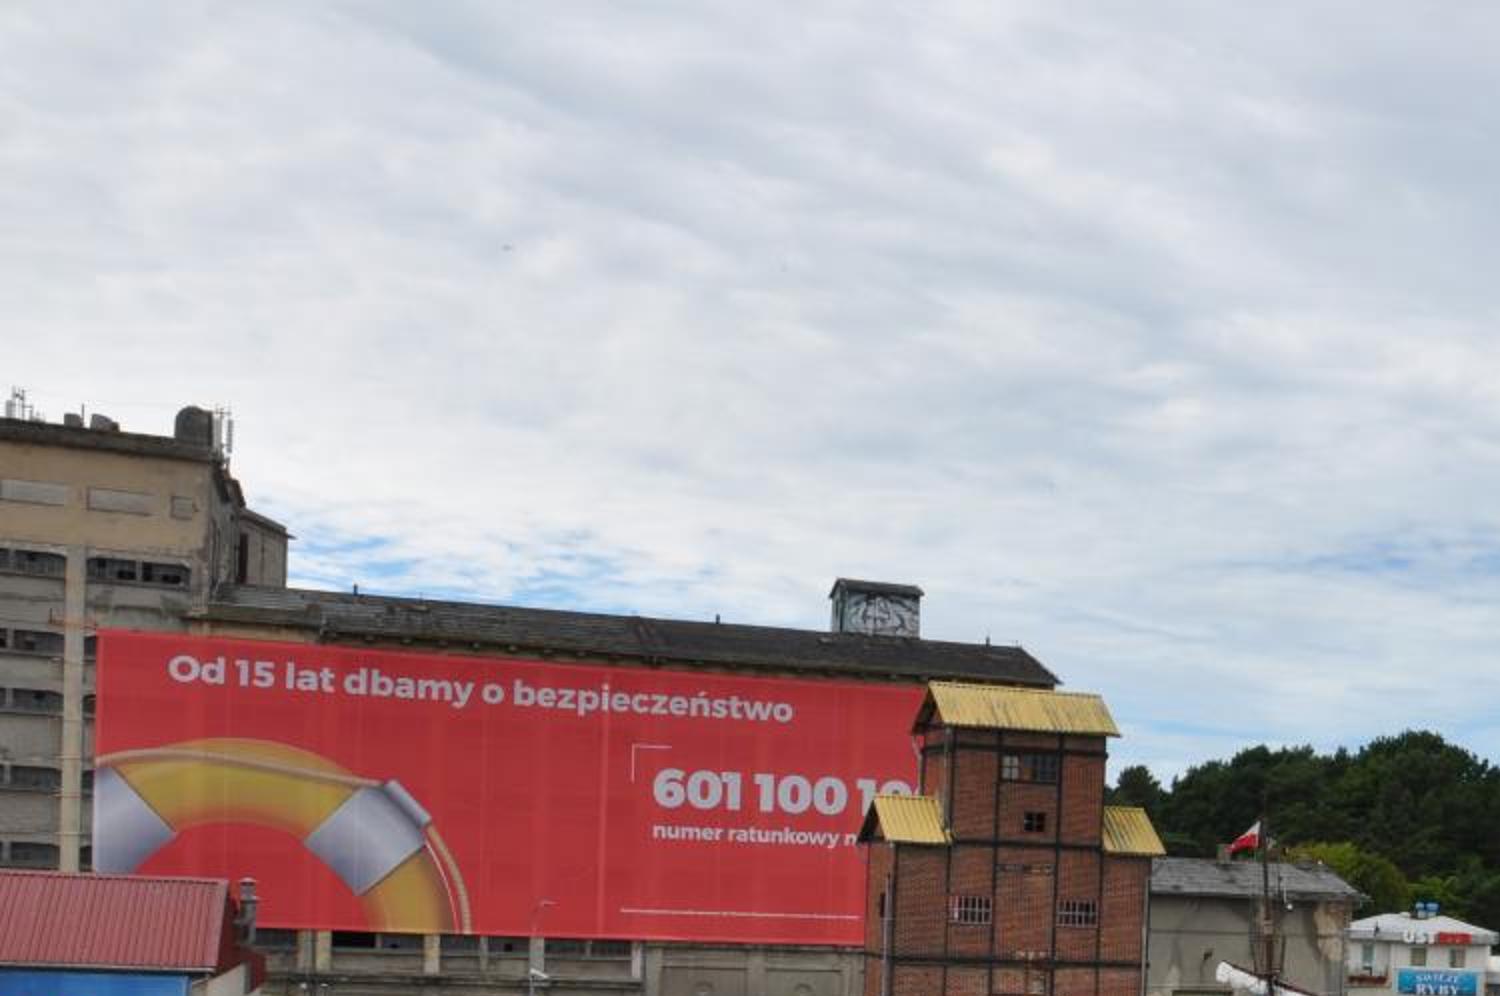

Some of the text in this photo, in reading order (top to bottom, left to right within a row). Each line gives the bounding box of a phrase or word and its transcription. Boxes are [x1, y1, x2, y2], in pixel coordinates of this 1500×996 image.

[168, 655, 794, 723] Od 15 lat dbamy o bezpieczeństwo
[653, 767, 742, 811] 601
[753, 772, 848, 816] 100
[652, 824, 723, 841] numer
[728, 826, 840, 849] ratunkowy
[1415, 984, 1458, 996] RYBY
